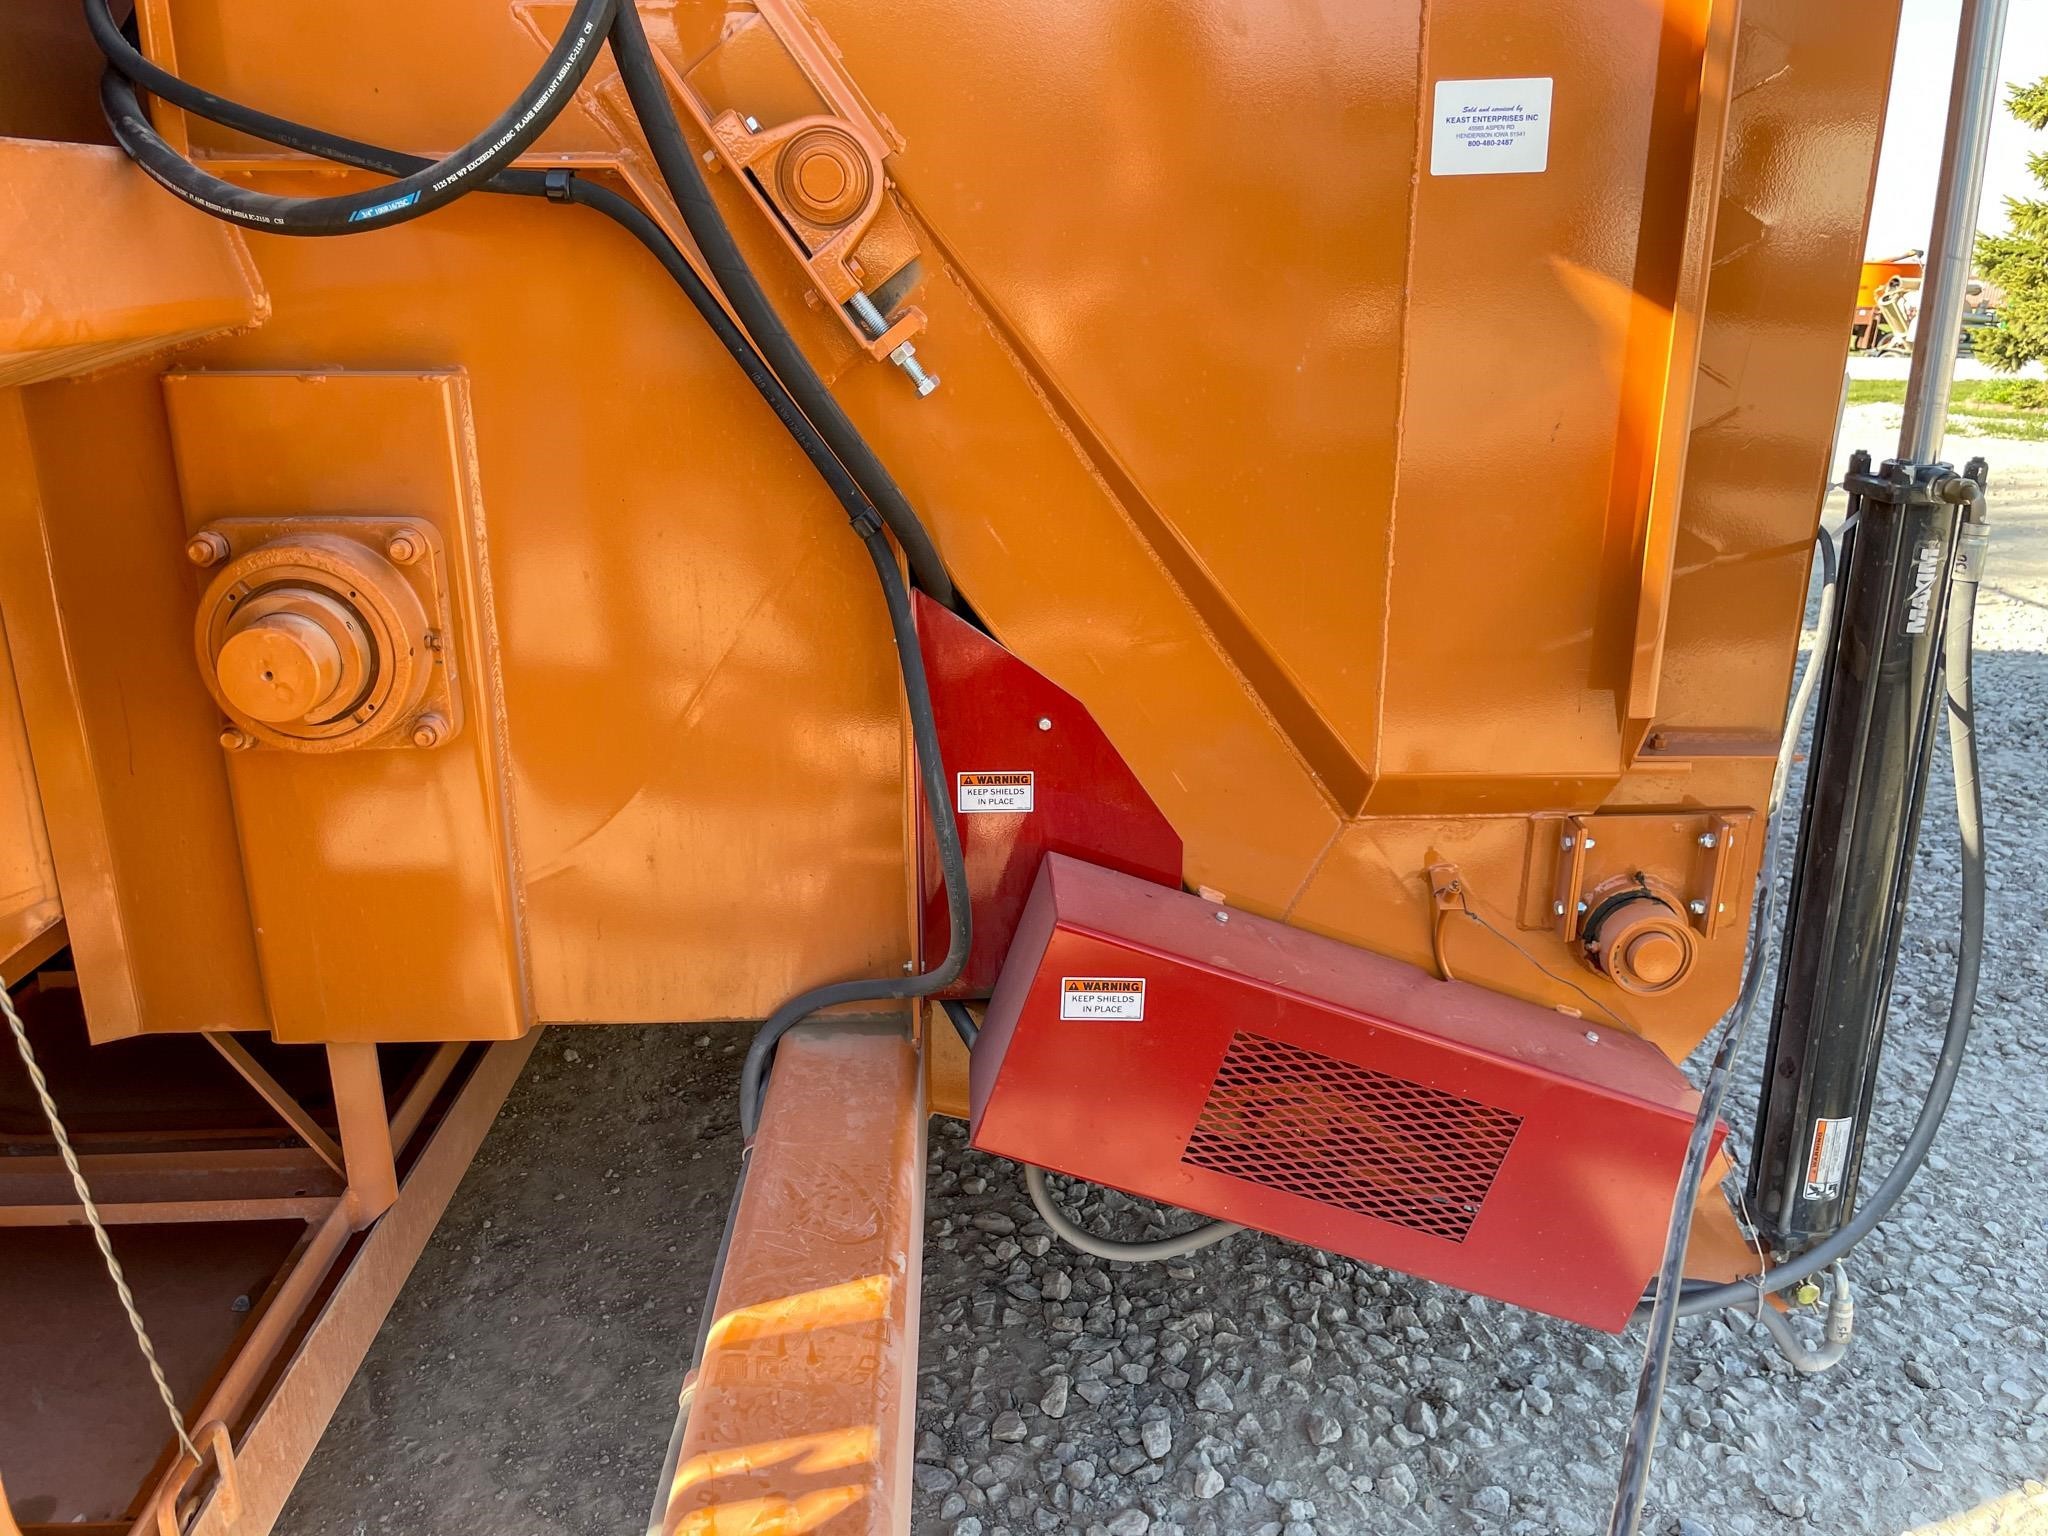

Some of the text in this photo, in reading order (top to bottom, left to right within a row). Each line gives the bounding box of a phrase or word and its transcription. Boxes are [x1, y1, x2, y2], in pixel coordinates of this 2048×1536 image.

[433, 180, 448, 191] 3125
[446, 174, 458, 184] PSI
[456, 168, 467, 177] WP
[466, 148, 495, 171] EXCEEDS
[493, 130, 516, 152] R16/2SC
[514, 111, 535, 132] FLAME
[532, 79, 560, 113] RESISTANT
[557, 63, 572, 82] MSHA
[584, 21, 594, 34] CSI
[1446, 116, 1471, 124] KEAST
[1473, 115, 1524, 123] ENTERPRISES
[189, 194, 206, 206] FLAME
[1906, 548, 1940, 633] MAXIM
[977, 776, 1028, 784] WARNING
[1083, 982, 1139, 991] WARNING
[1812, 1132, 1822, 1167] WARNING
